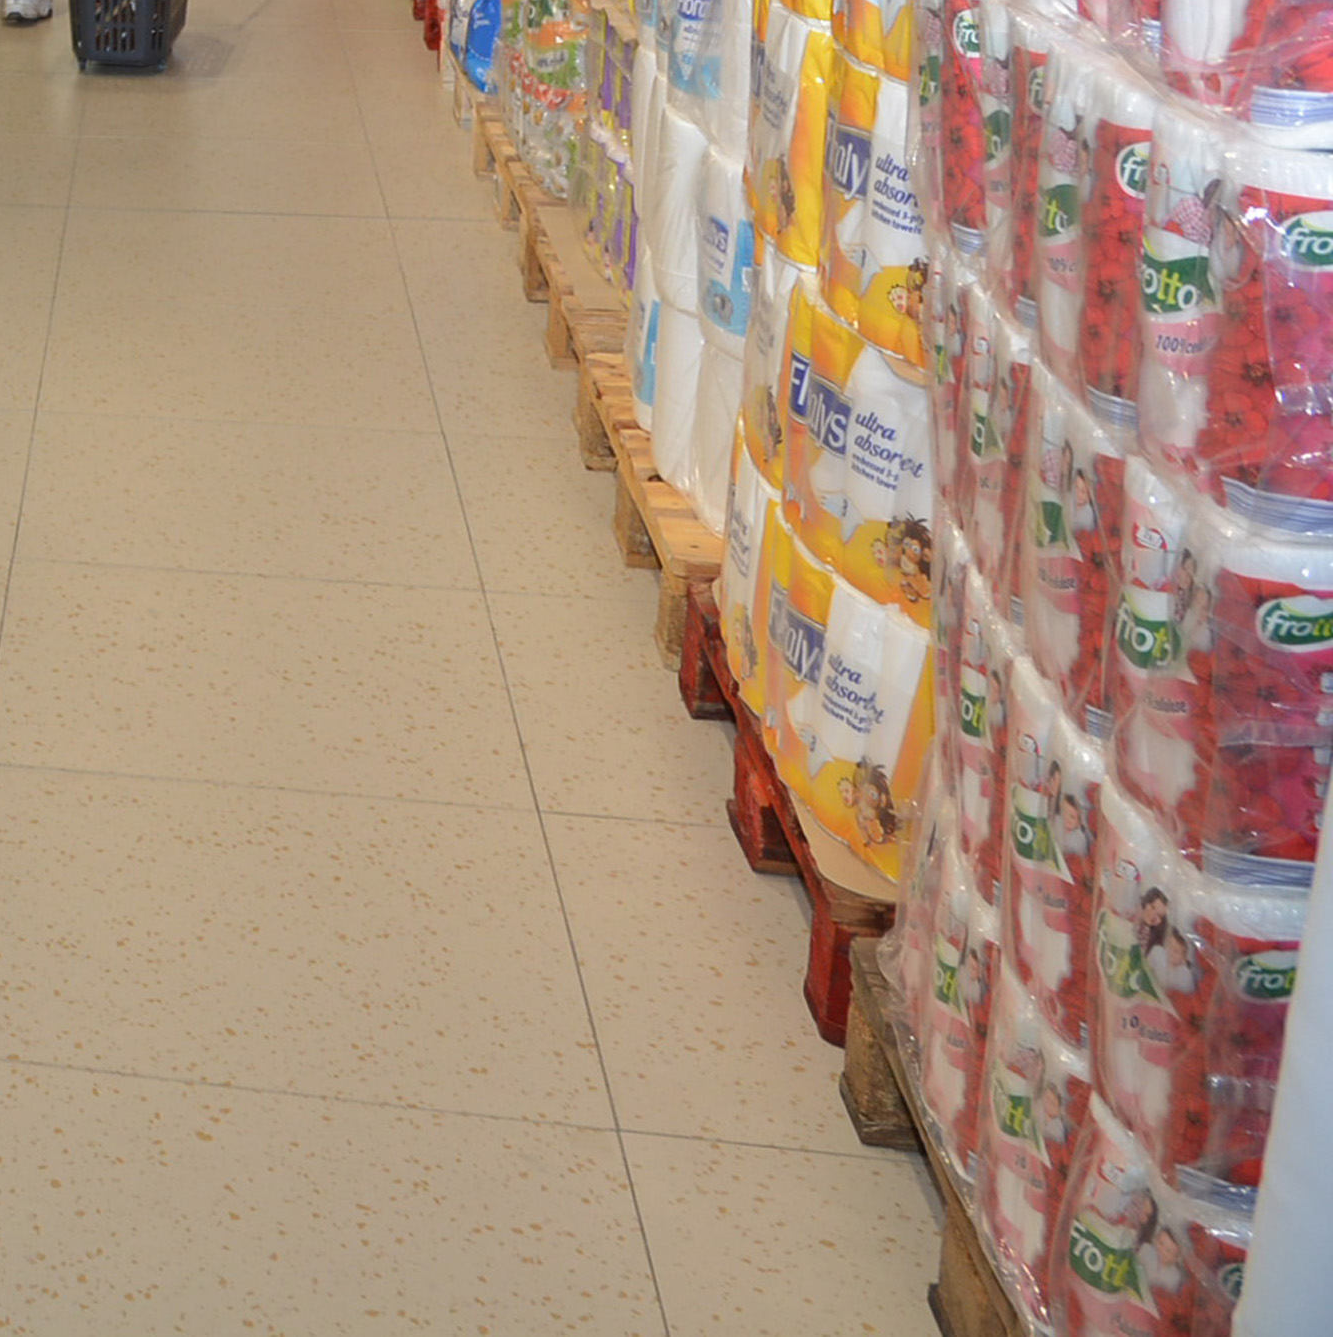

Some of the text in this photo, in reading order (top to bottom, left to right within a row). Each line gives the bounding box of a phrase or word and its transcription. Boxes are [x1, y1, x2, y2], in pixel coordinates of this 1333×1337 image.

[875, 154, 909, 182] ultra
[855, 412, 896, 441] ultra
[1264, 613, 1333, 637] frott
